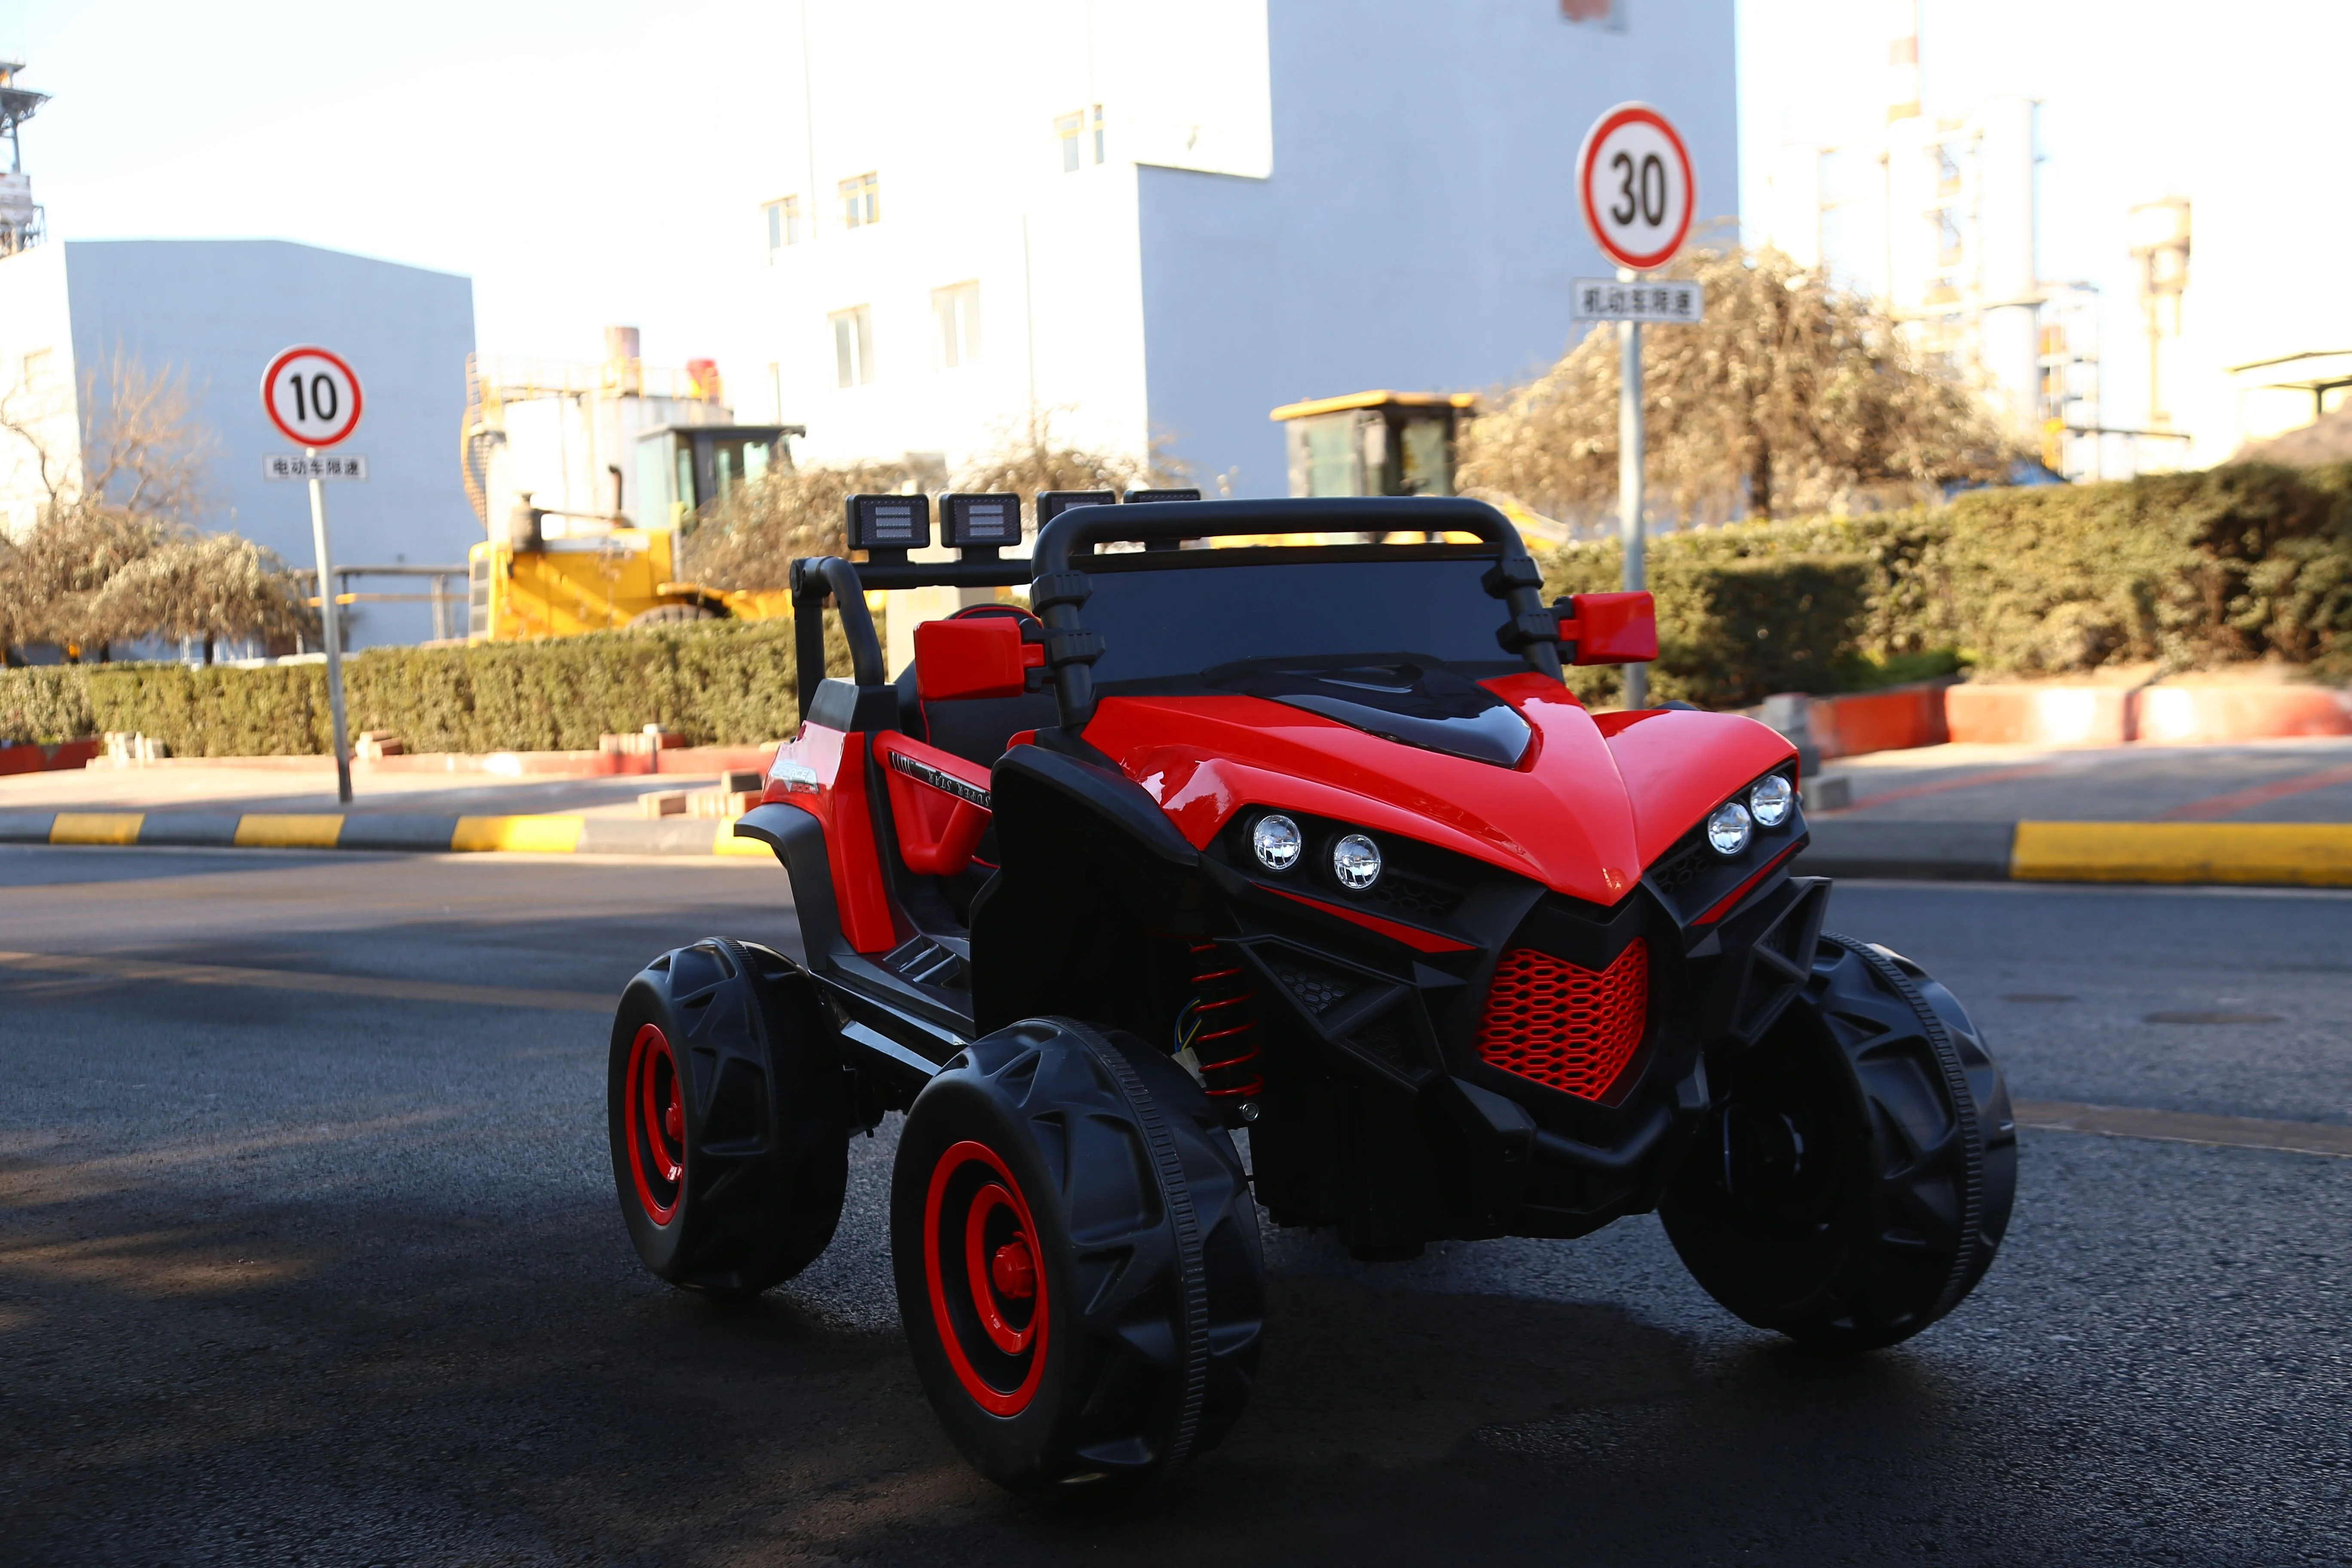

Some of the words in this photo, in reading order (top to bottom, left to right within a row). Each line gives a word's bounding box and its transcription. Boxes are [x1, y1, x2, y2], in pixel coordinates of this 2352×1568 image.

[1612, 151, 1666, 227] 30
[289, 372, 338, 422] 10
[927, 770, 952, 791] STAR
[956, 782, 990, 806] SUPER
